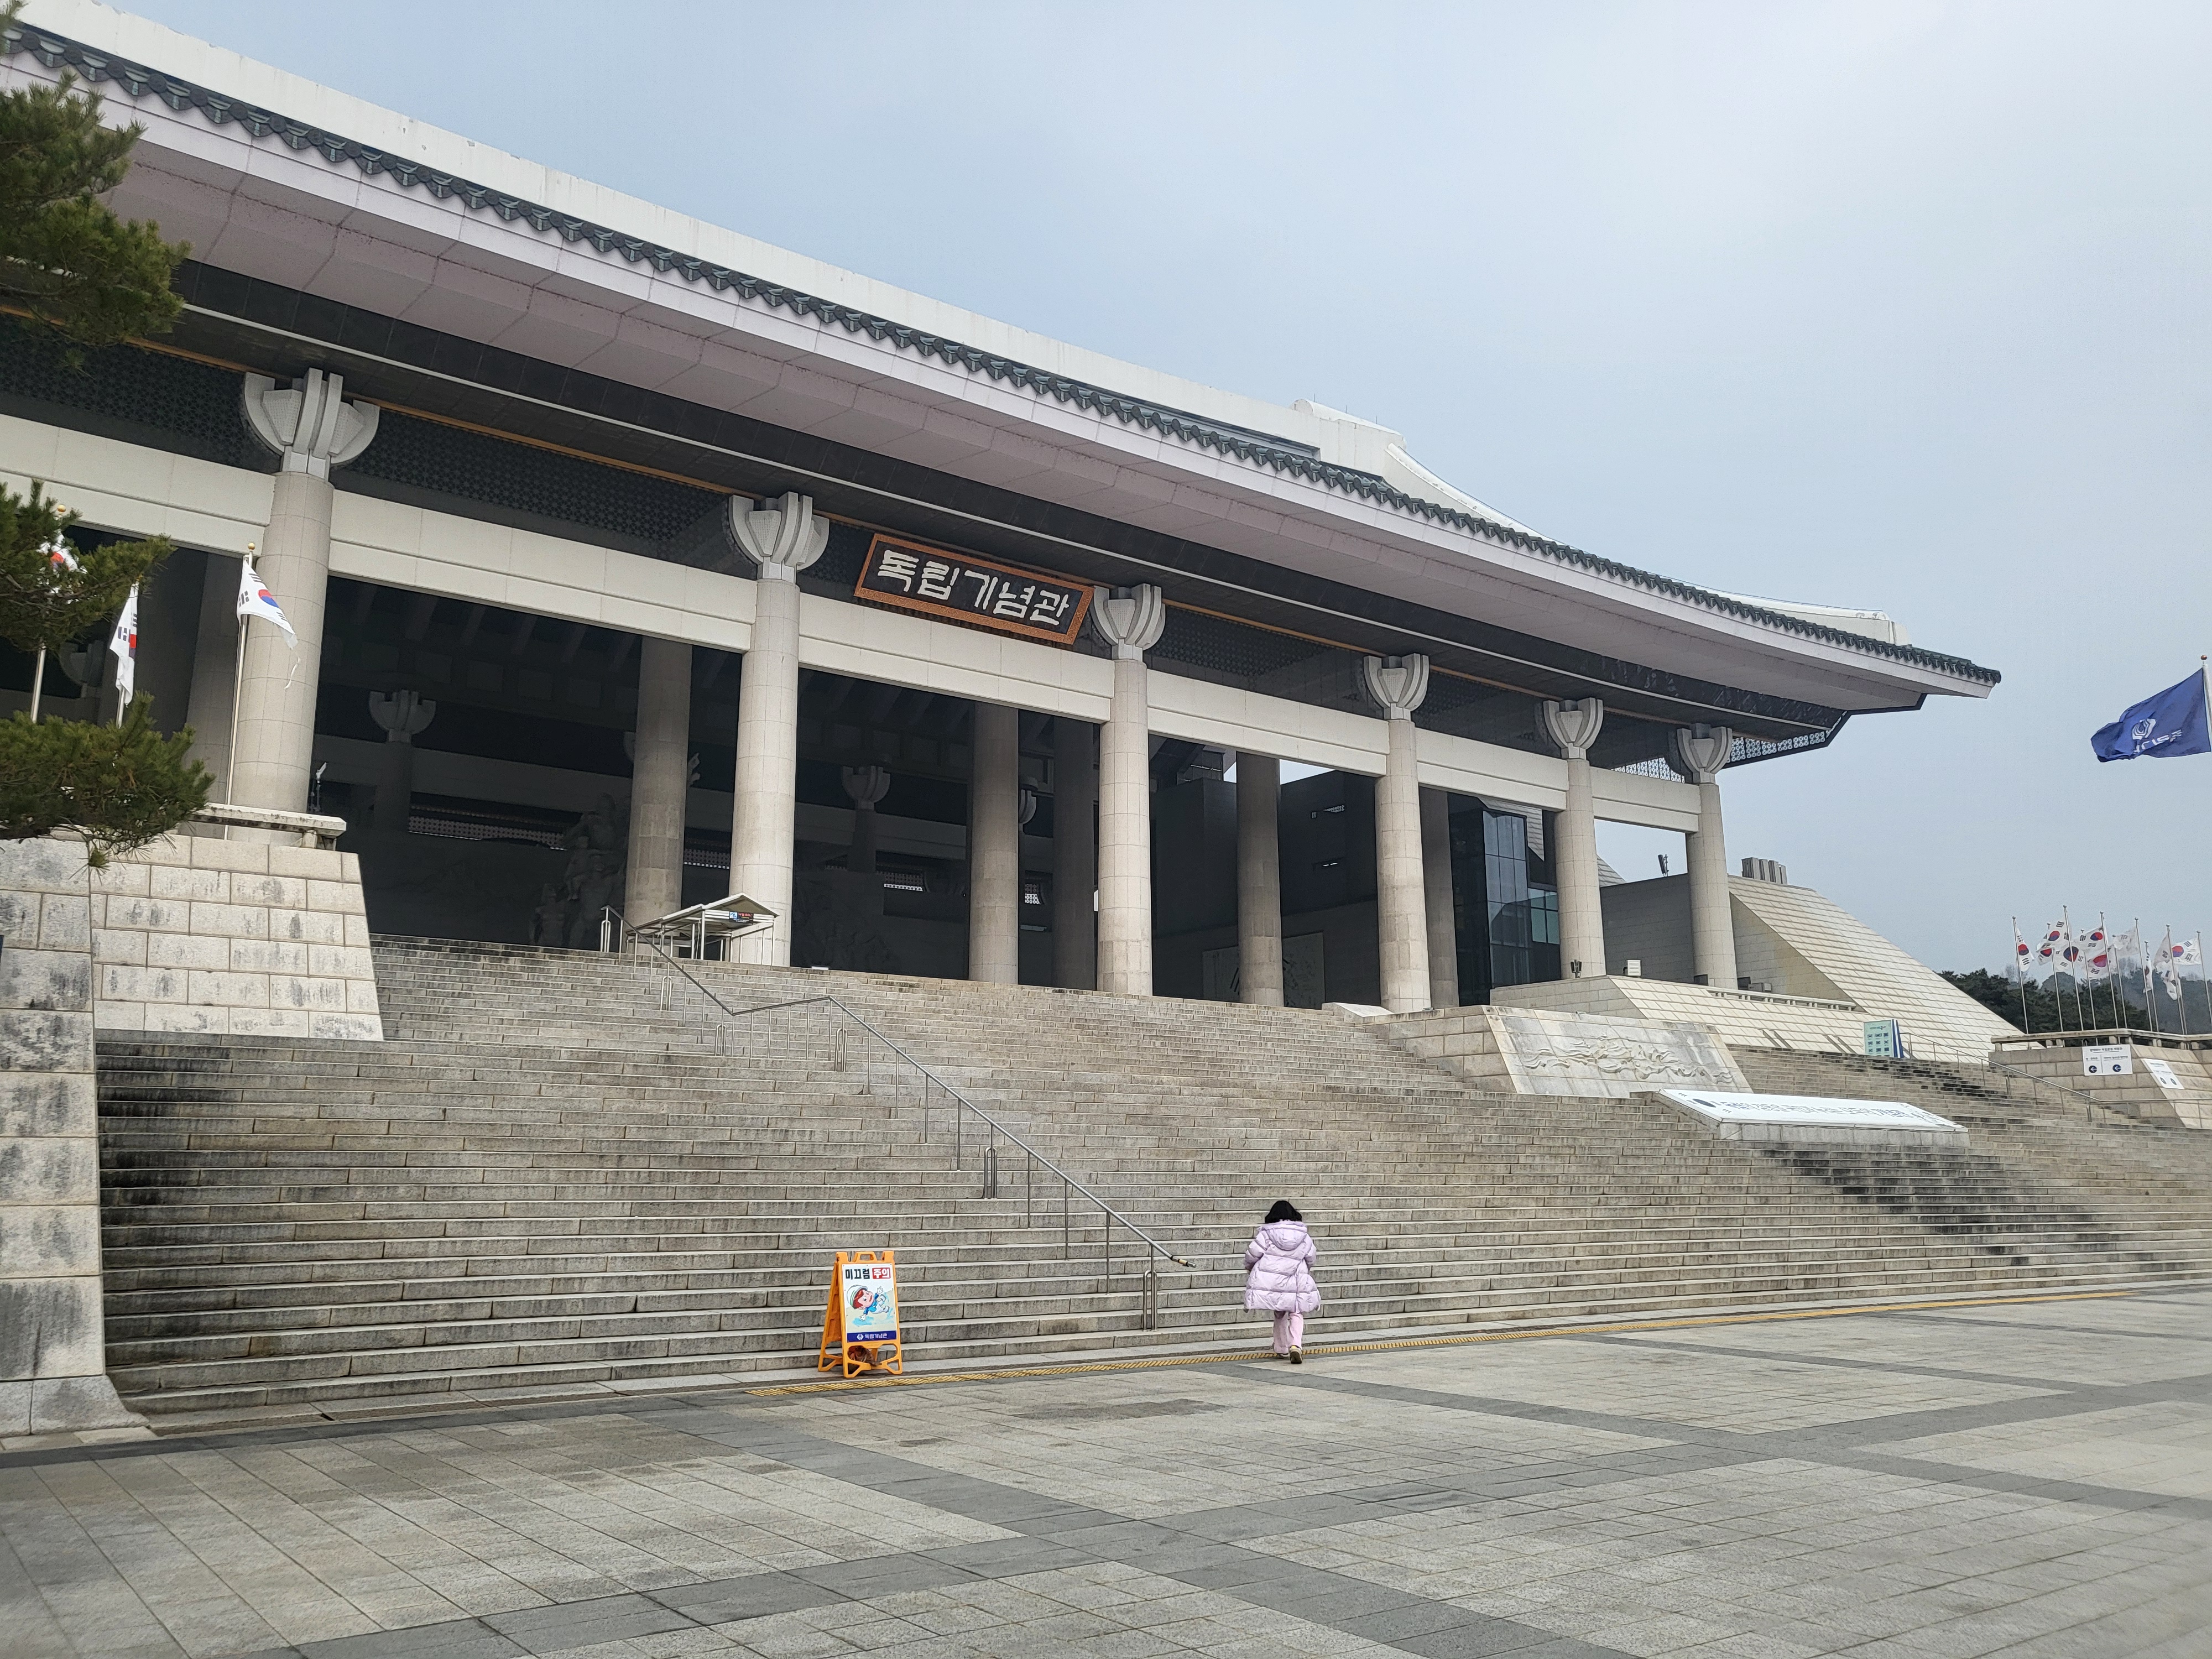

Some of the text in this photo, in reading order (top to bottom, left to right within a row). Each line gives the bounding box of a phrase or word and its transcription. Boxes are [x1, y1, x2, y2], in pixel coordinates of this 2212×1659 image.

[877, 549, 1070, 625] 독립기념관
[1720, 1102, 1760, 1110] 독립의
[1751, 1103, 1791, 1112] 감동을
[1781, 1105, 1819, 1114] 국민과
[1838, 1107, 1882, 1117] 모두의
[1870, 1109, 1914, 1118] 기념관
[845, 1268, 890, 1280] 미끄럼 주의
